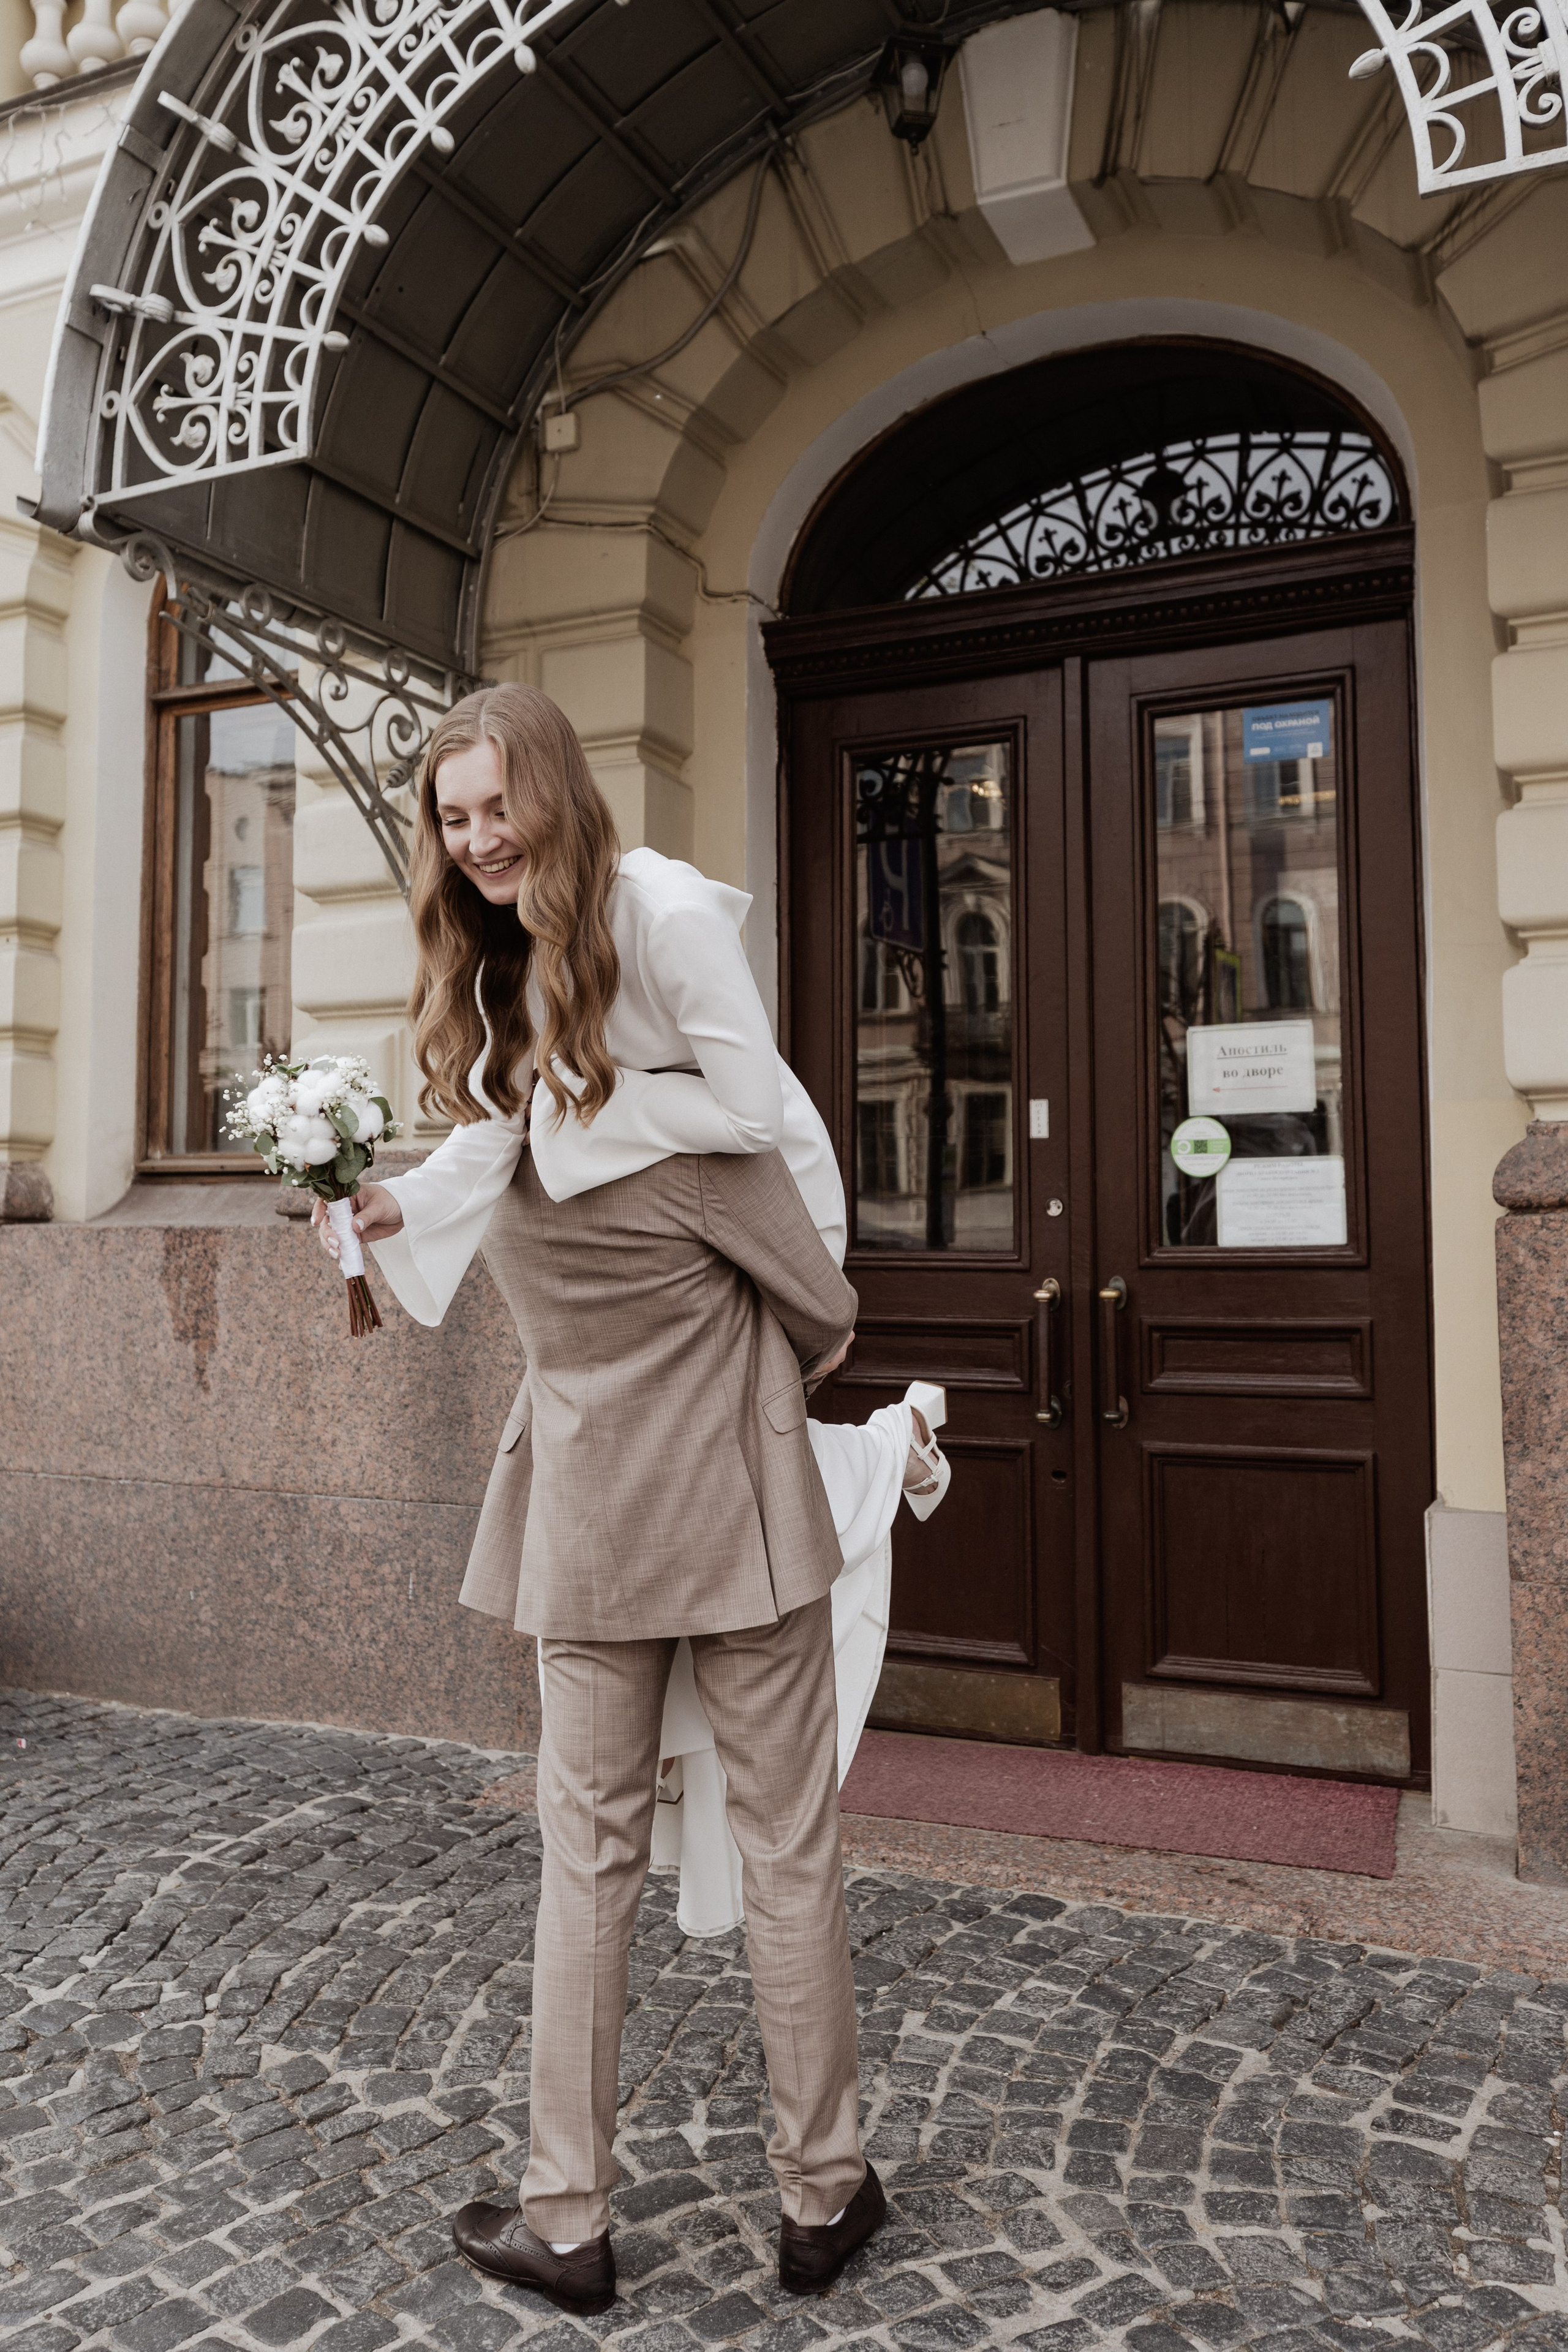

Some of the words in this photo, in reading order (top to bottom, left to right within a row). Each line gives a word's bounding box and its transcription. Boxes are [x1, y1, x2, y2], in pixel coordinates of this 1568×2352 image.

[1251, 722, 1273, 731] ПОД
[1274, 715, 1320, 728] ОХРАНОЙ
[1218, 1044, 1286, 1057] Апостиль
[1243, 1066, 1283, 1078] дворе
